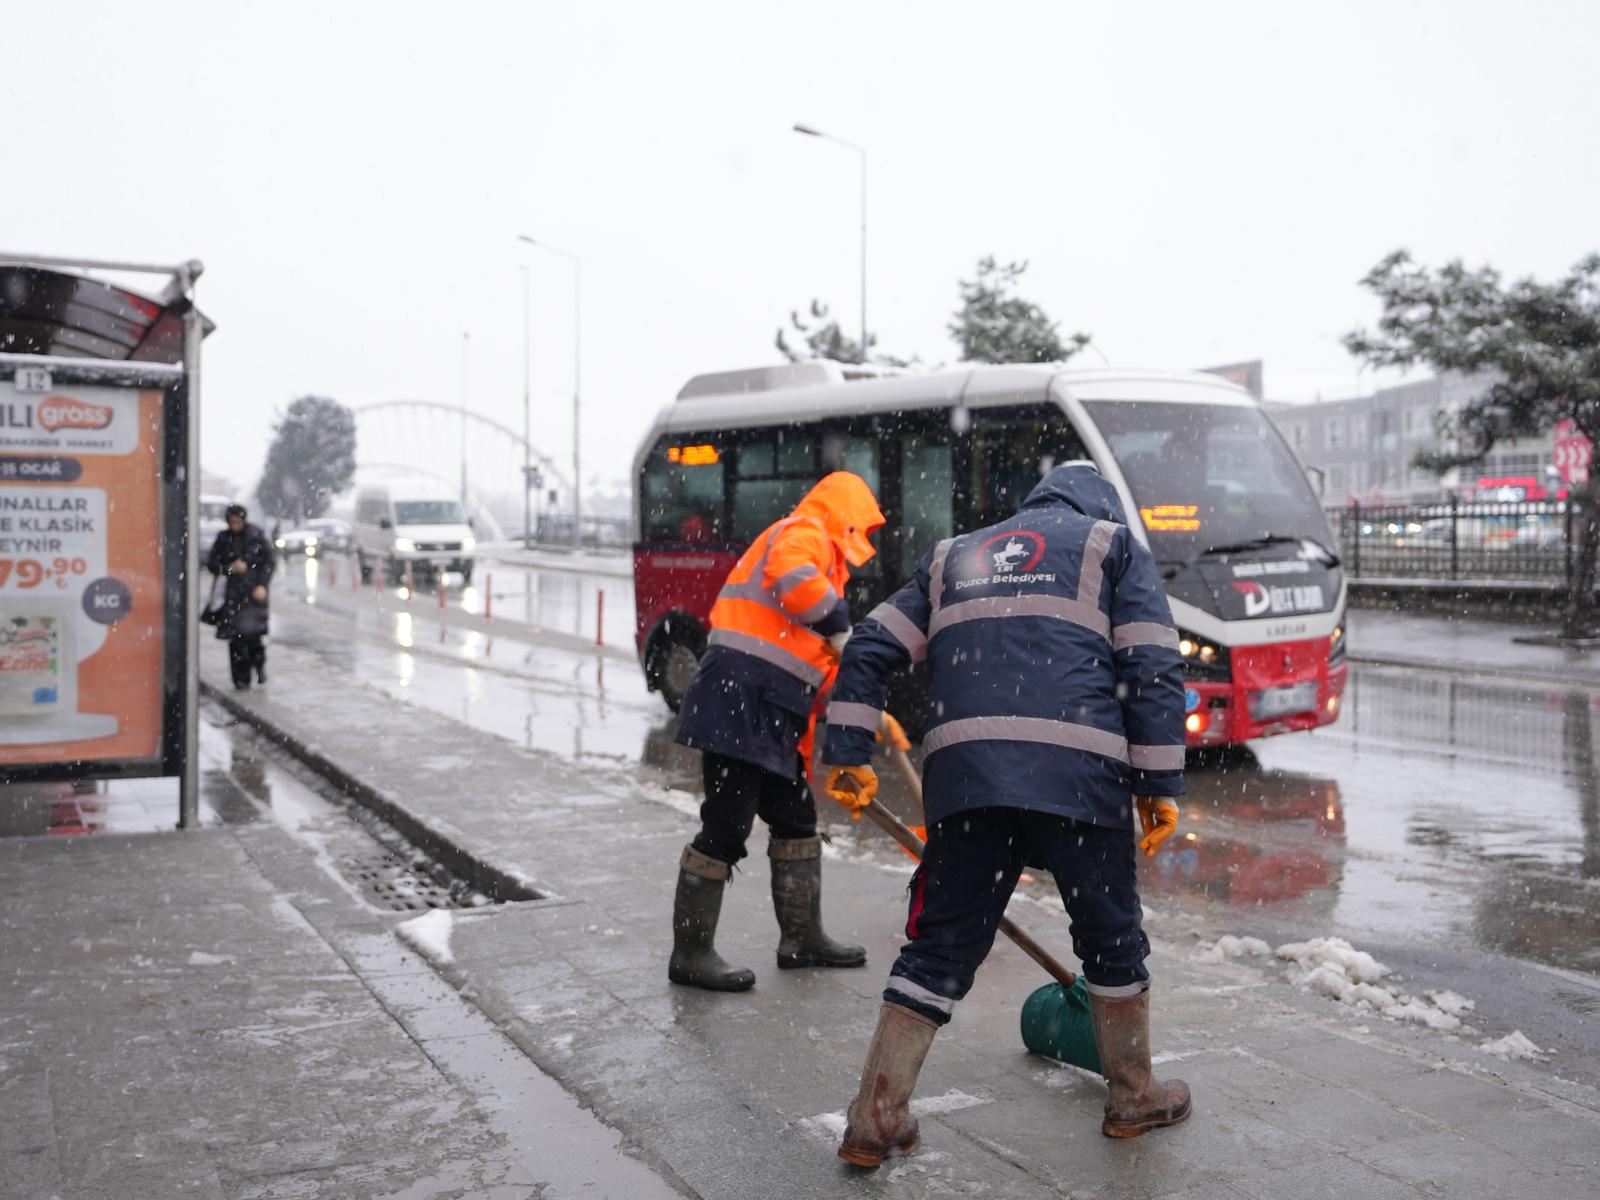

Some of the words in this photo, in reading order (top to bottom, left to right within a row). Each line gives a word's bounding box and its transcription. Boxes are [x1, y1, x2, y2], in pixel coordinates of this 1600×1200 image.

[42, 405, 108, 426] gross
[0, 497, 88, 511] NALLAR
[20, 514, 95, 532] KLASİK
[992, 573, 1056, 584] Belediyesi
[94, 593, 120, 608] KG
